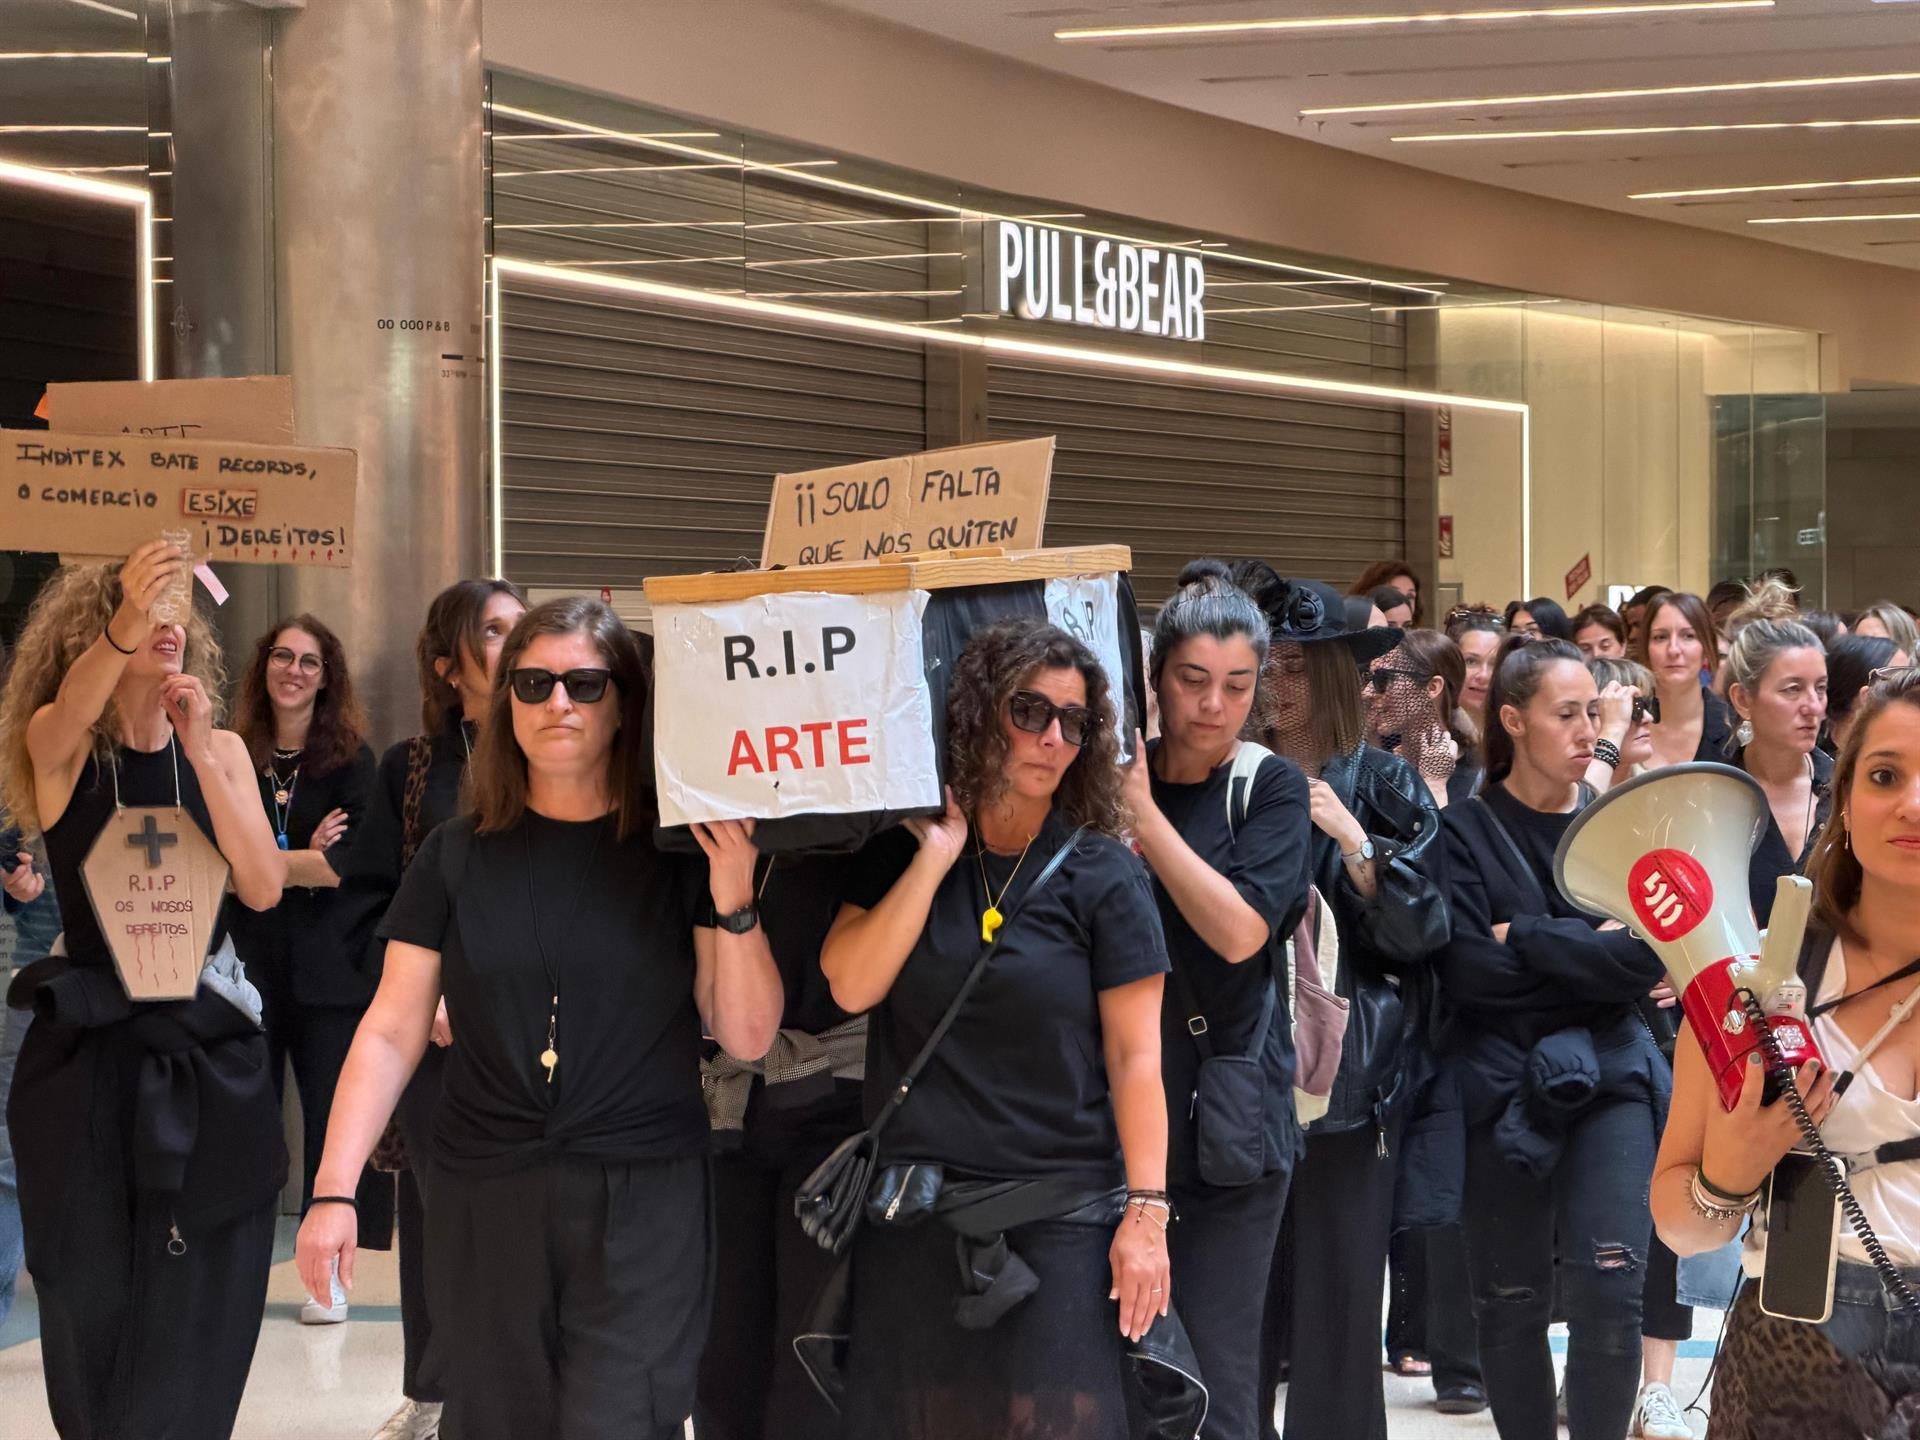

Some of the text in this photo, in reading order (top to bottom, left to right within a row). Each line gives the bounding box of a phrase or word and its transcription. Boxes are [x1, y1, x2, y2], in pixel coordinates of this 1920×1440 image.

[1000, 221, 1205, 341] PULL&BEAR
[16, 443, 318, 480] INDITEX BATE RECORDS,
[17, 484, 257, 517] O COMERCIO ESIXE
[920, 466, 1000, 502] FALTA
[798, 516, 1019, 566] QUE NOS QUITEN
[723, 625, 857, 682] R.I.P
[726, 718, 871, 777] ARTE
[128, 874, 176, 892] R.I.P
[114, 900, 193, 913] OS NOSOS
